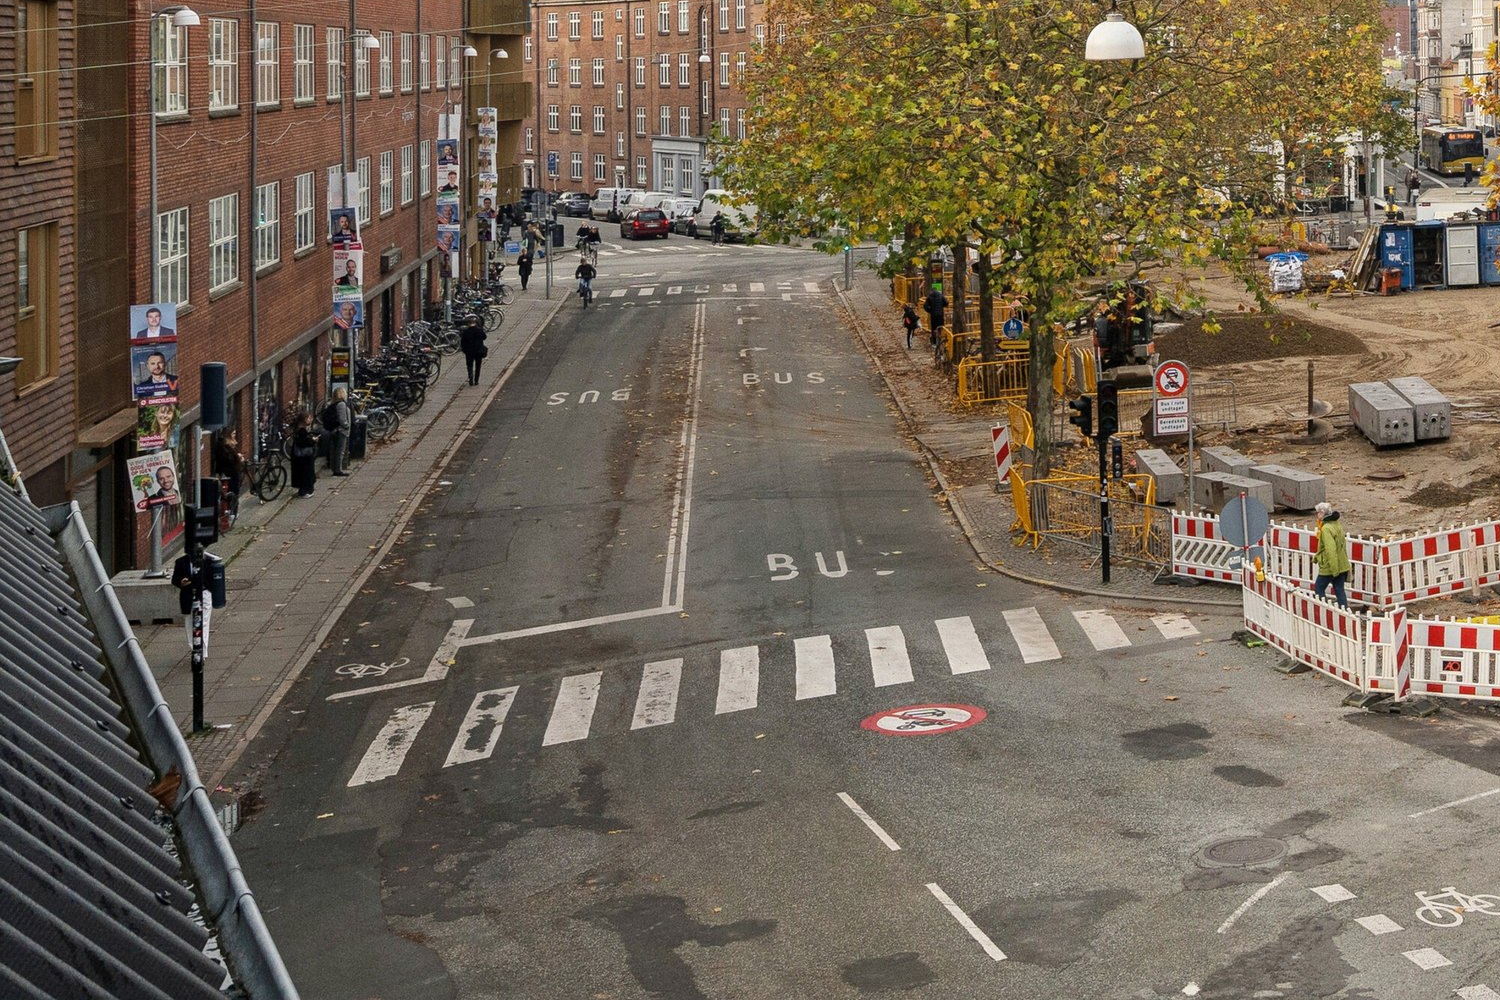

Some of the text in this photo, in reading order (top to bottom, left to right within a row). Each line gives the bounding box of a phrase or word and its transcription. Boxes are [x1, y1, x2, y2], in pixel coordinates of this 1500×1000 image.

[742, 372, 826, 385] BUS
[546, 387, 633, 406] BUS
[1443, 661, 1461, 671] AO
